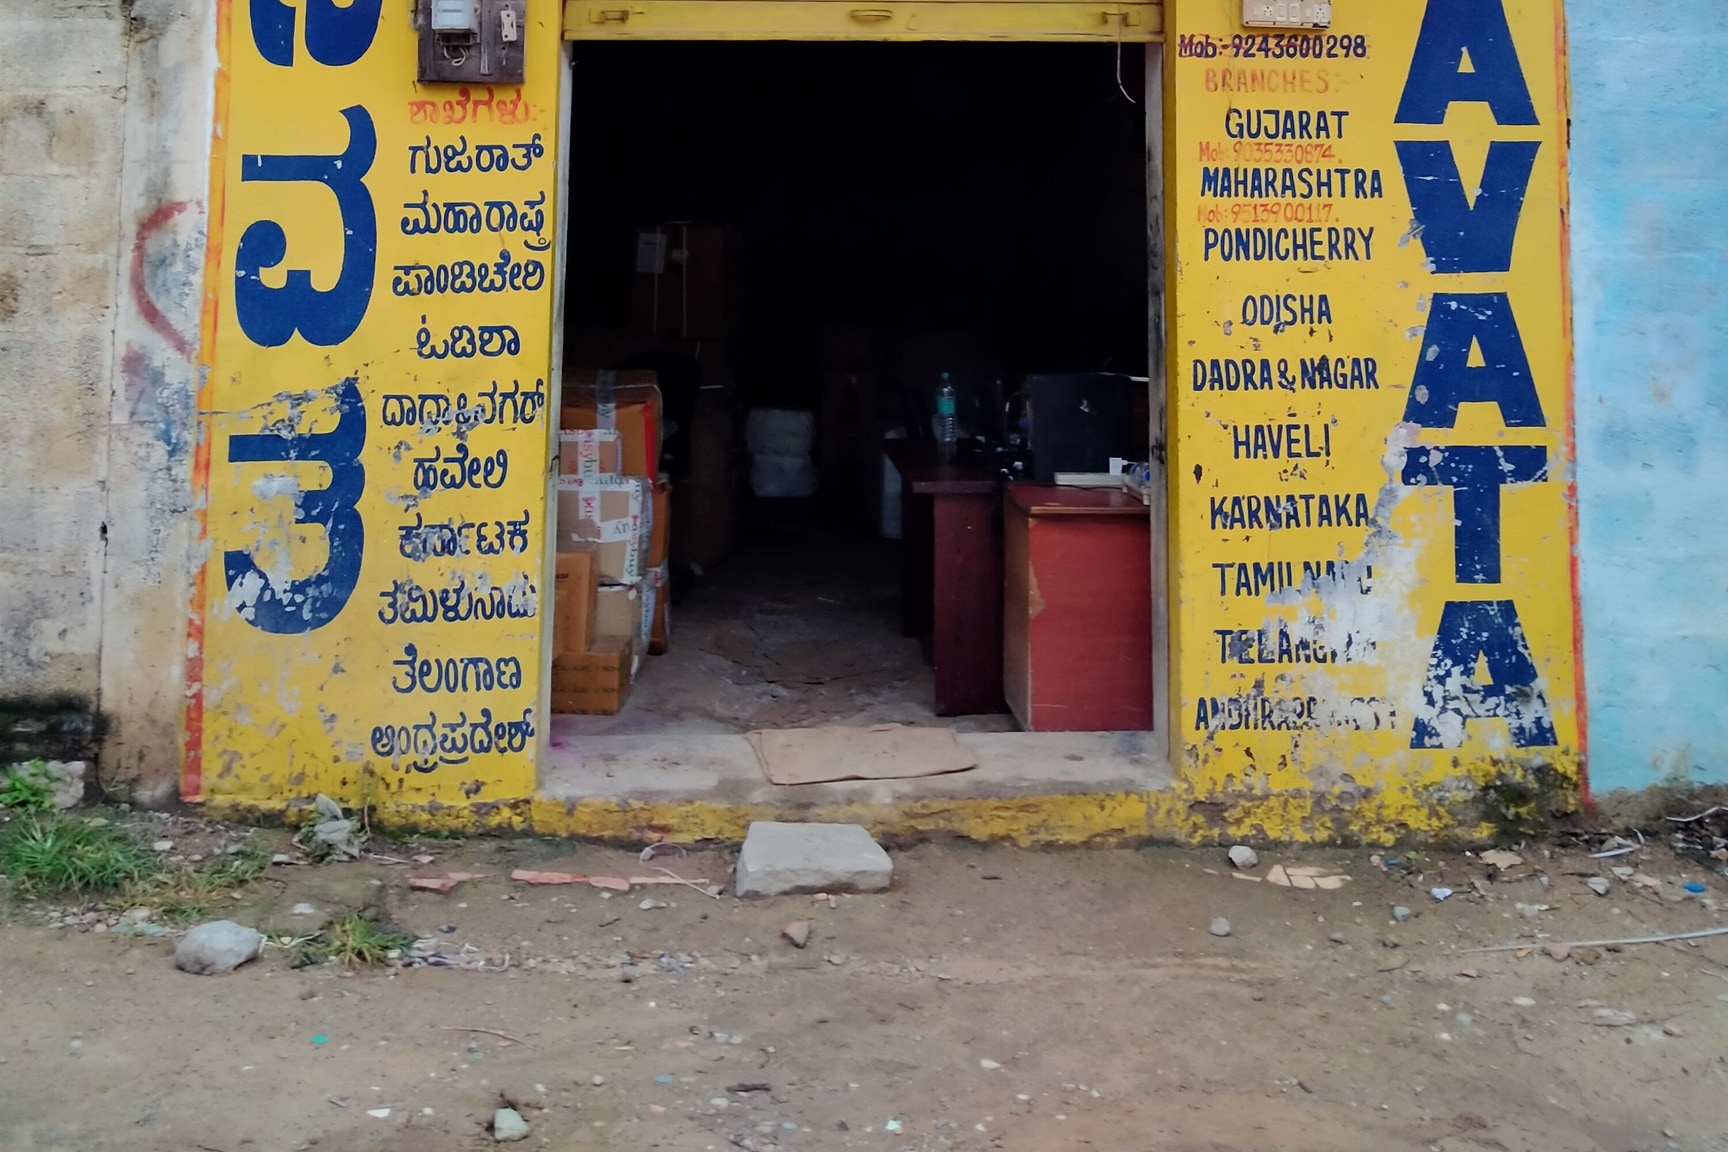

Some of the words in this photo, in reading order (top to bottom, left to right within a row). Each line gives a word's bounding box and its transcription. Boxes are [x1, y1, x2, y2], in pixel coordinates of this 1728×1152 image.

[1225, 108, 1349, 140] GUJARAT
[408, 133, 545, 174] ಗುಜರಾತ್
[1200, 166, 1383, 199] MAHARASHTRA
[1204, 226, 1375, 261] PONDICHERRY
[392, 249, 546, 296] ಪಾಂಡಿಚೇರಿ
[1241, 294, 1332, 326] ODISHA
[1233, 423, 1331, 459] HAVELI
[413, 443, 508, 490] ಹವೇಲಿ
[1210, 493, 1369, 530] KARNATAKA
[392, 643, 522, 693] ತೆಲಂಗಾಣ
